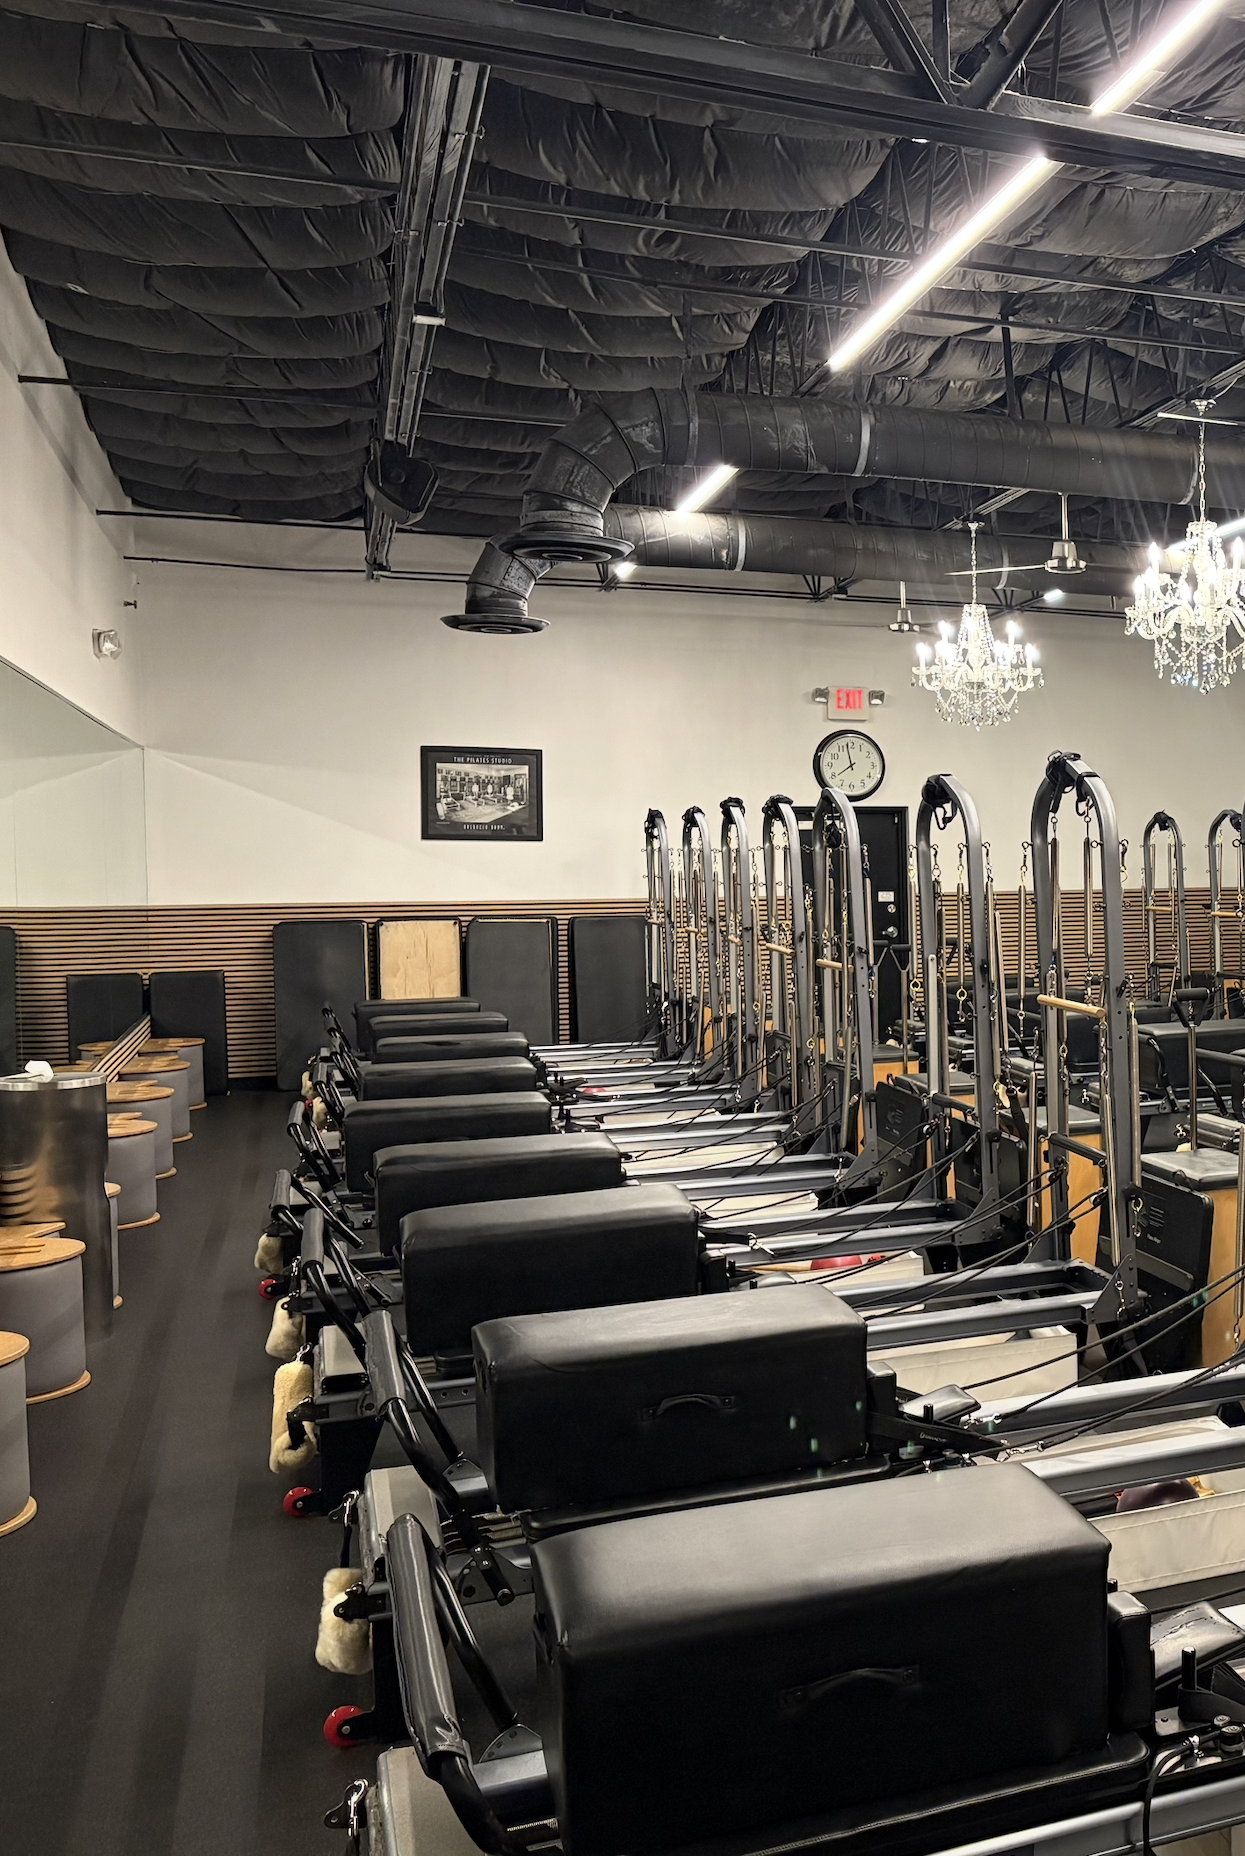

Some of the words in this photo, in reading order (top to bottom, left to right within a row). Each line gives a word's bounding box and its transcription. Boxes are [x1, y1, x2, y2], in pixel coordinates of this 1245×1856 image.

[836, 689, 863, 709] EXIT
[837, 744, 845, 752] 11
[830, 752, 839, 760] 10
[865, 751, 871, 759] 2
[827, 761, 833, 770] 9
[870, 761, 875, 770] 3
[830, 771, 836, 780] 8
[866, 771, 872, 779] 4
[839, 779, 844, 787] 7
[848, 781, 855, 790] 6
